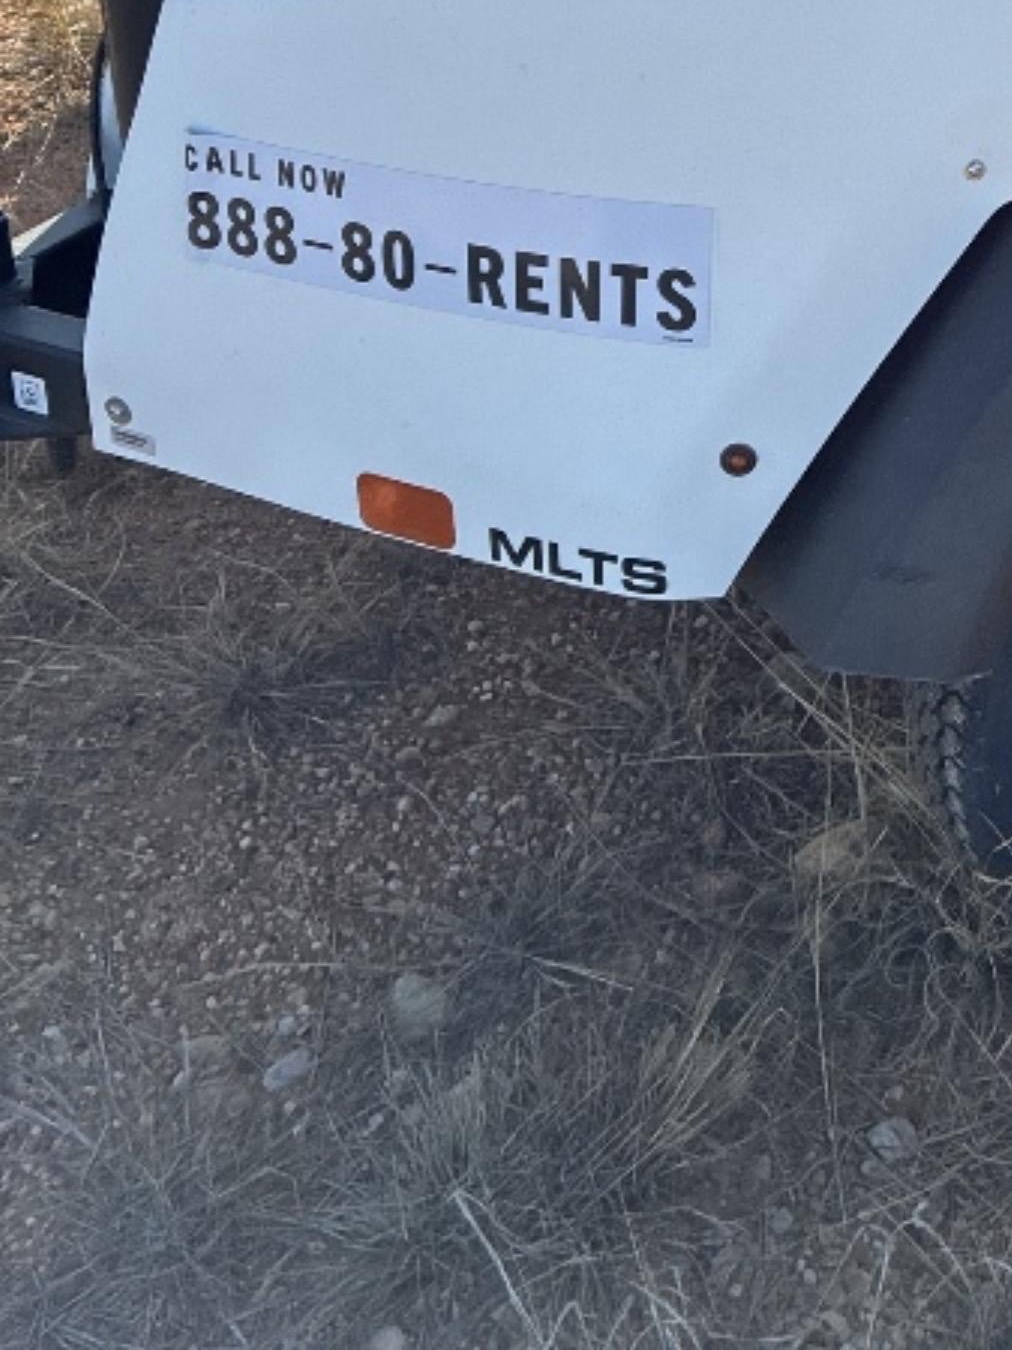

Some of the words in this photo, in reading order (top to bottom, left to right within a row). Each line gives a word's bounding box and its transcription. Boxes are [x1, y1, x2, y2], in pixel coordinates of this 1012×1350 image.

[184, 144, 262, 181] CALL
[278, 158, 346, 198] NOW
[187, 191, 697, 332] 888-80-RENTS
[488, 528, 668, 595] MLTS
